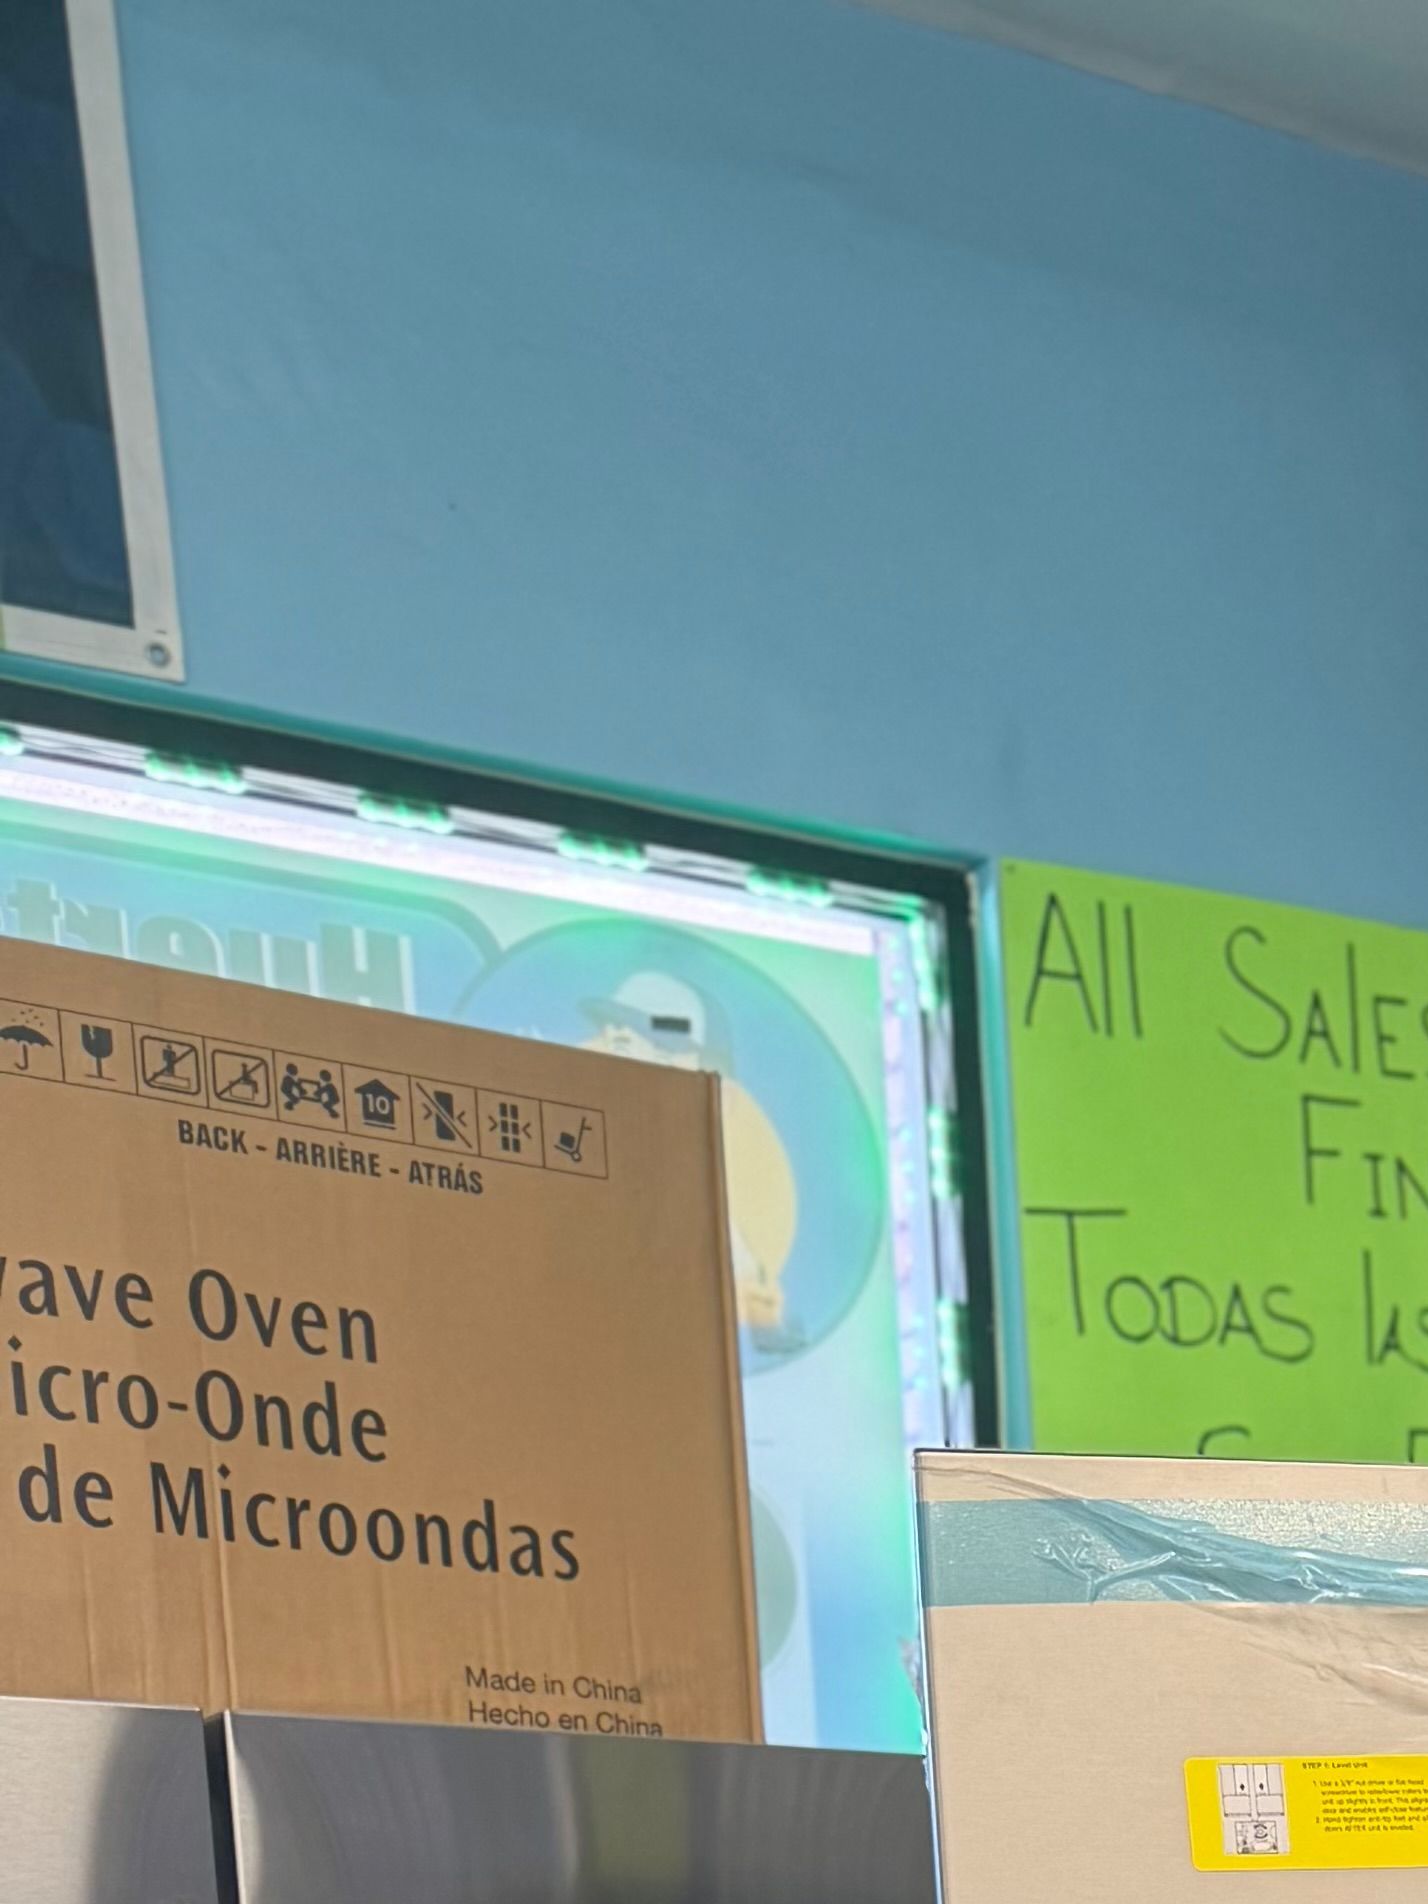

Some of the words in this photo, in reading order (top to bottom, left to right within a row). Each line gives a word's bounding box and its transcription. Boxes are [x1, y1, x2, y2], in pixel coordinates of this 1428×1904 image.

[178, 1118, 248, 1155] BACK
[275, 1139, 381, 1178] ARRIÈRE
[408, 1159, 484, 1195] ATRÁS
[0, 1255, 153, 1330] ave
[188, 1267, 378, 1364] Oven
[8, 1335, 388, 1463] icro-Onde
[18, 1443, 114, 1529] de
[149, 1461, 580, 1581] Microondas
[464, 1665, 536, 1696] Made
[543, 1671, 564, 1697] in
[572, 1675, 642, 1704] China
[468, 1703, 551, 1729] Hecho
[559, 1711, 588, 1731] en
[596, 1711, 663, 1738] China
